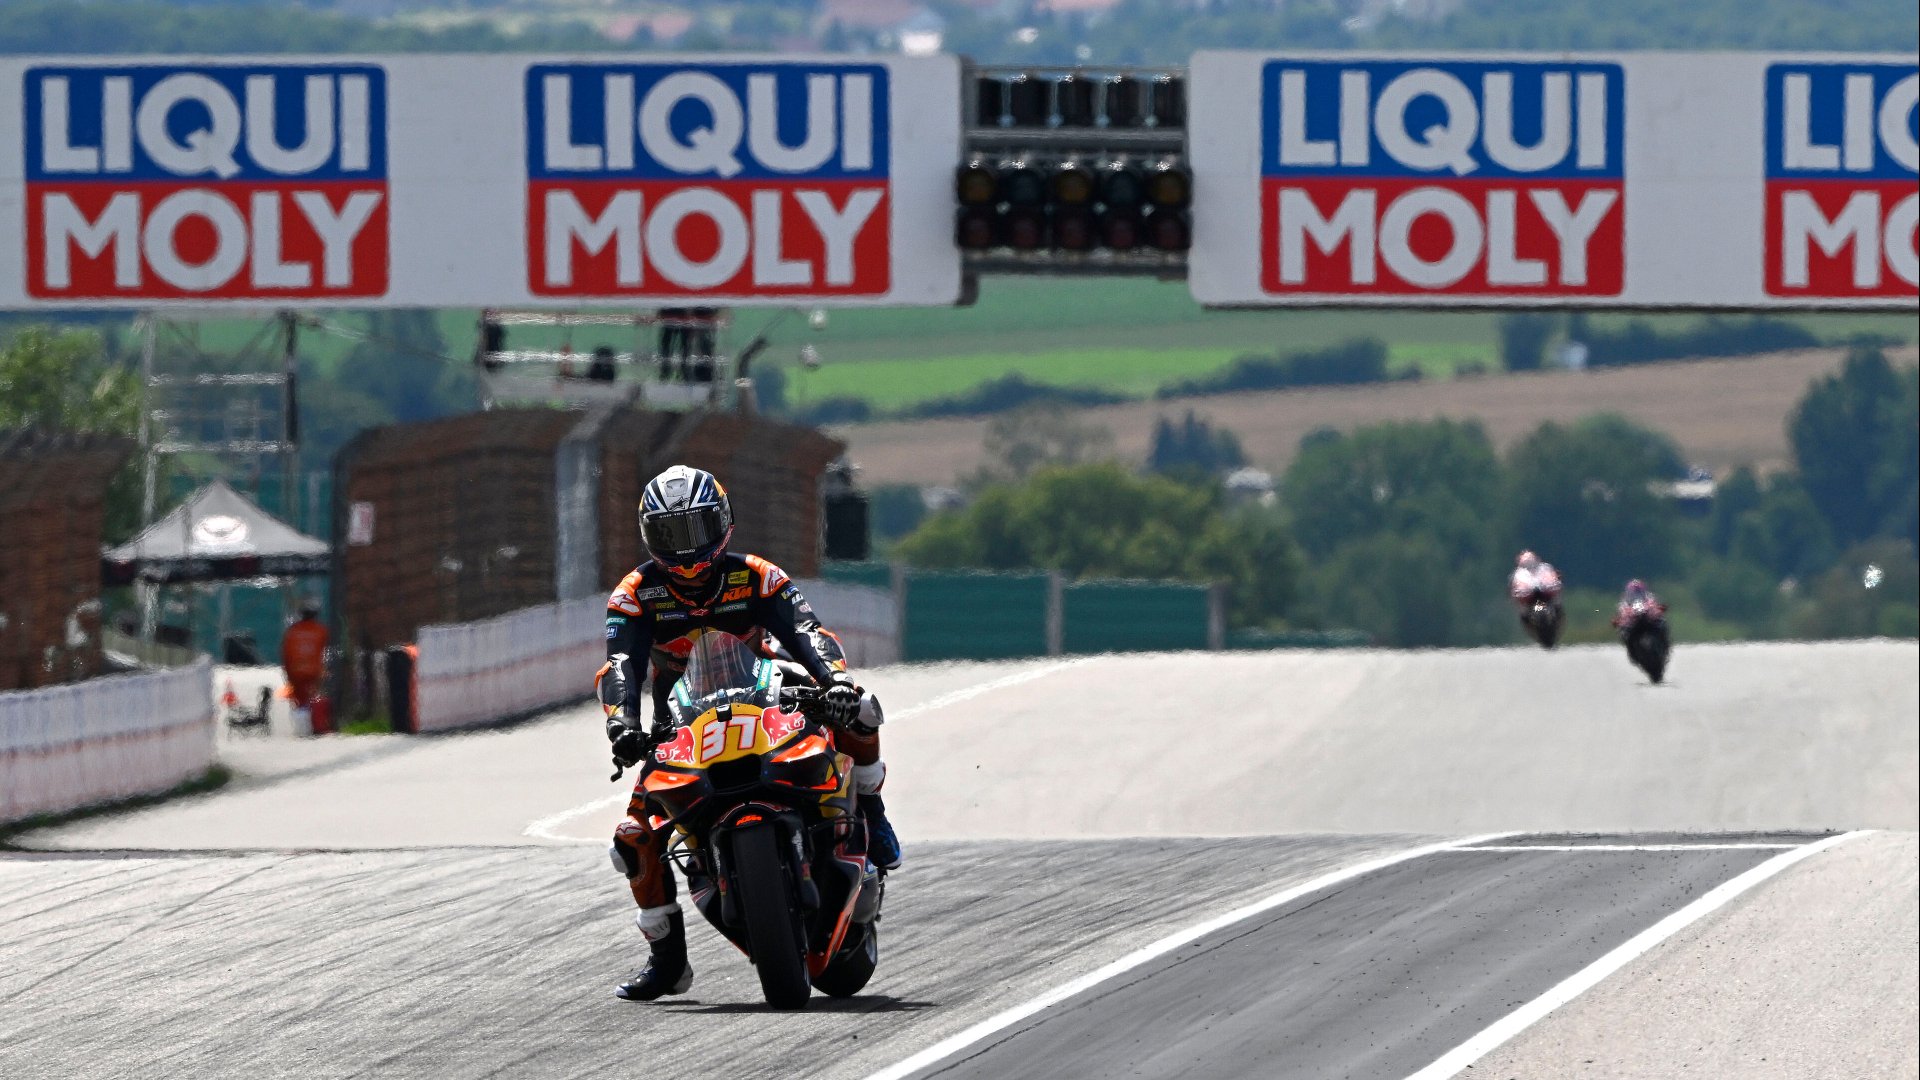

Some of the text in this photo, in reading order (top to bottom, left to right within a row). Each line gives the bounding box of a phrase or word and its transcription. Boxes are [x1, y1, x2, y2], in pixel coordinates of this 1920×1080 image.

[44, 75, 368, 178] LIQUI
[545, 73, 871, 178] LIQUI
[1280, 70, 1606, 176] LIQUI
[44, 190, 381, 291] MOLY
[545, 188, 883, 288] MOLY
[1279, 187, 1617, 287] MOLY
[721, 586, 753, 603] KTM
[700, 714, 761, 764] 37
